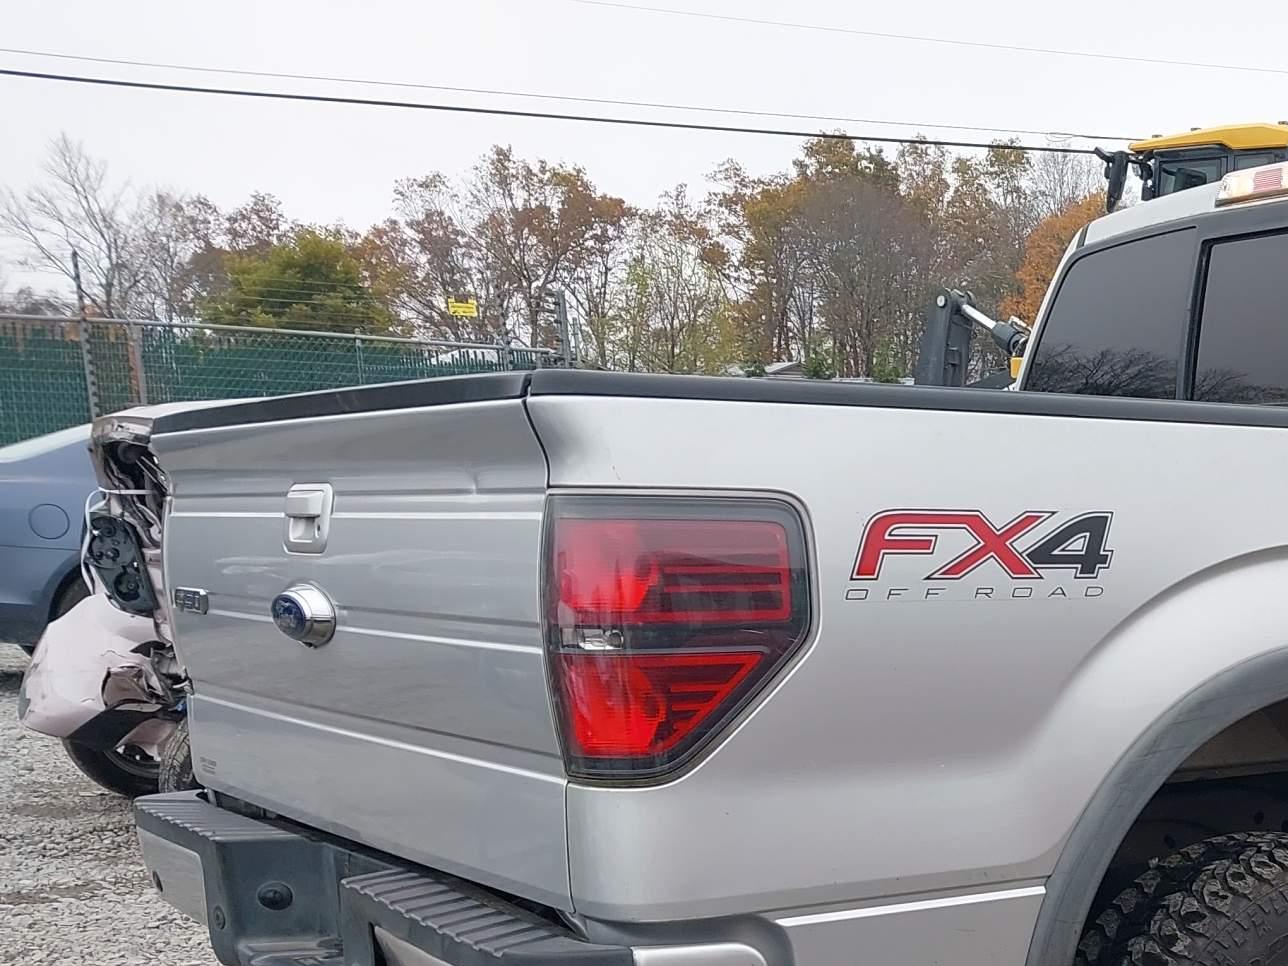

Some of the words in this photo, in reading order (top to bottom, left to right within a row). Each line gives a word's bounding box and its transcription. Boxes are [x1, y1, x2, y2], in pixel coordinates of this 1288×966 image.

[849, 508, 1115, 582] FX4
[845, 586, 948, 601] OFF
[974, 586, 1105, 600] ROAD
